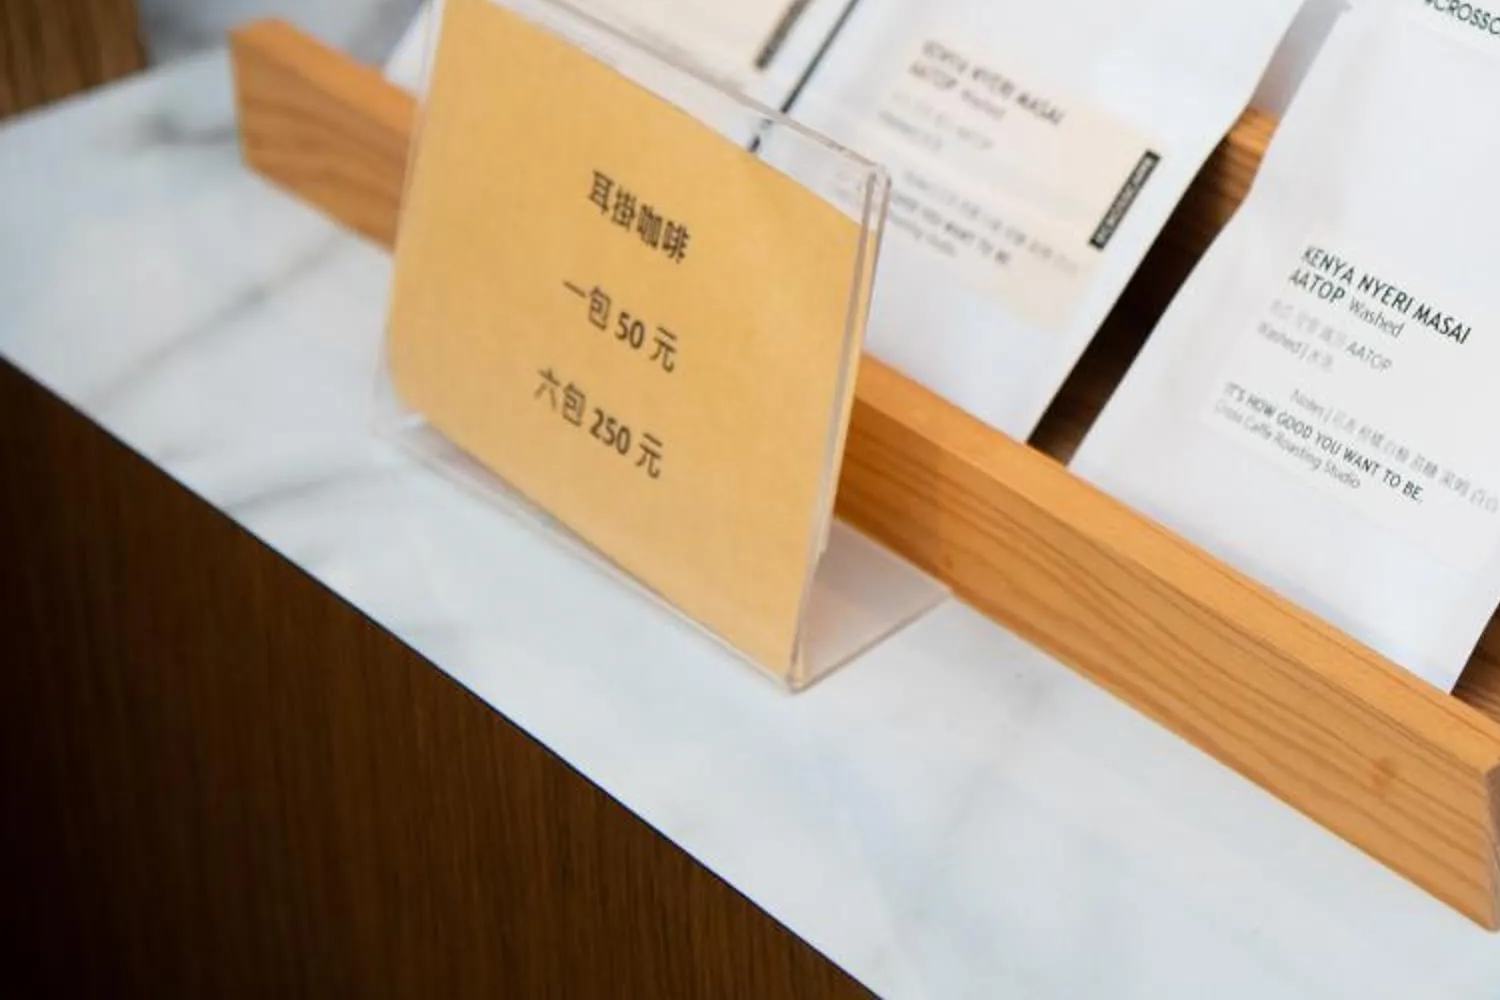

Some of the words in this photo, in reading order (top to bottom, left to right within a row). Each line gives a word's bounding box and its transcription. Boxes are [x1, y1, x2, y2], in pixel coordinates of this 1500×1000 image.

[588, 169, 690, 264] 耳掛咖啡
[562, 279, 613, 332] 一包
[615, 309, 645, 350] 50
[650, 325, 678, 373] 元
[1289, 267, 1346, 304] AATOP
[1349, 297, 1405, 339] Washed
[1302, 245, 1353, 285] KENYA
[1357, 273, 1415, 313] NYERI
[1412, 302, 1472, 345] MASAI
[533, 366, 586, 427] 六包
[589, 407, 632, 455] 250
[635, 431, 663, 479] 元
[1246, 393, 1277, 418] HOW
[1277, 411, 1314, 439] GOOD
[1315, 429, 1345, 455] YOU
[1343, 447, 1381, 476] WANT
[1383, 468, 1401, 488] TO
[1403, 480, 1424, 503] BE.
[1325, 459, 1361, 490] Studio
